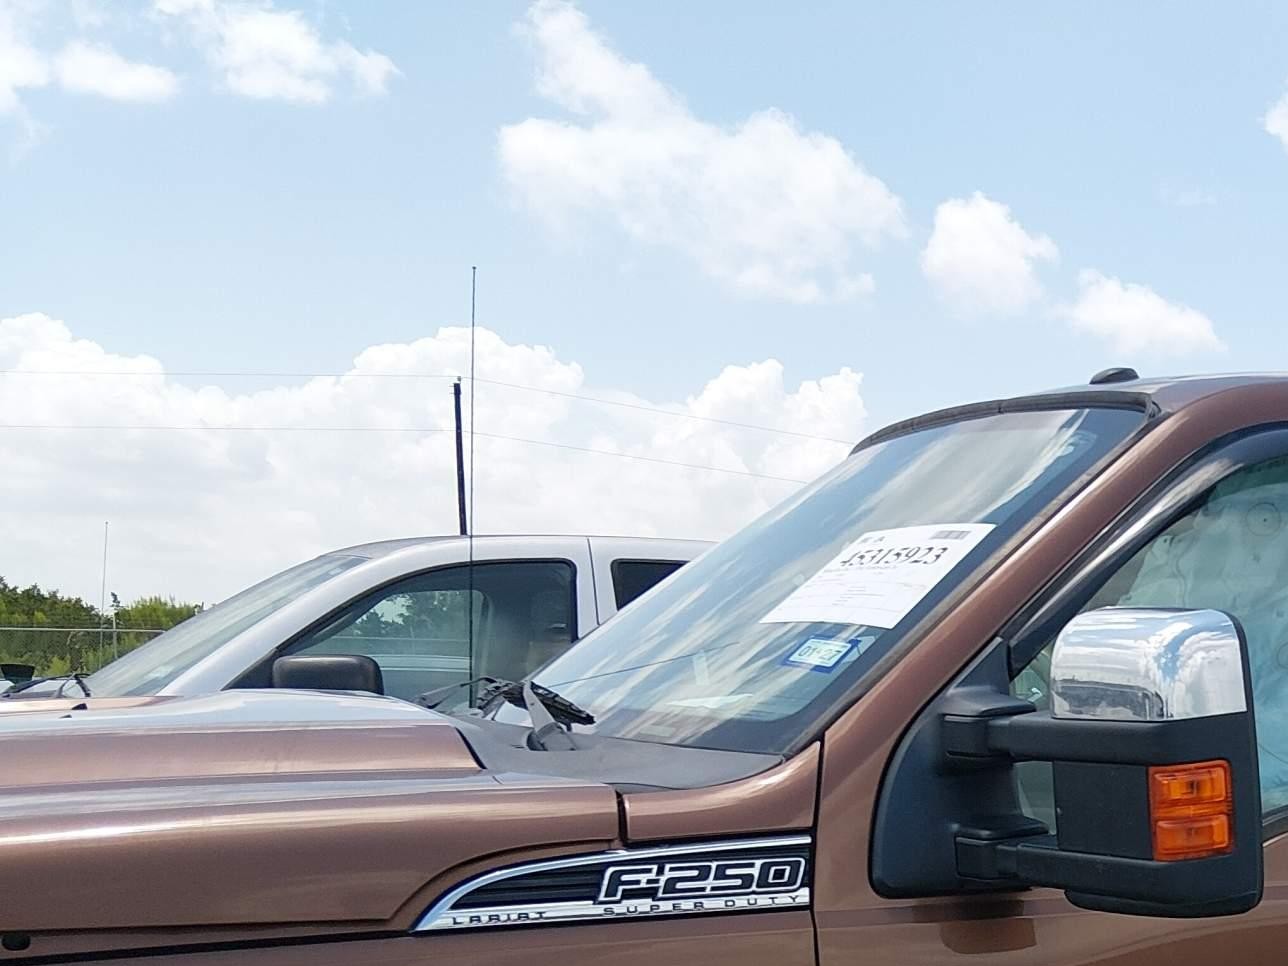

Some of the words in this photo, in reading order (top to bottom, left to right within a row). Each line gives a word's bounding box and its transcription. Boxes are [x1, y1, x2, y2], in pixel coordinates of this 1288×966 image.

[840, 546, 948, 567] 45315923
[603, 901, 705, 916] SUPER
[724, 894, 801, 908] DUTY
[452, 910, 547, 925] LARIAT
